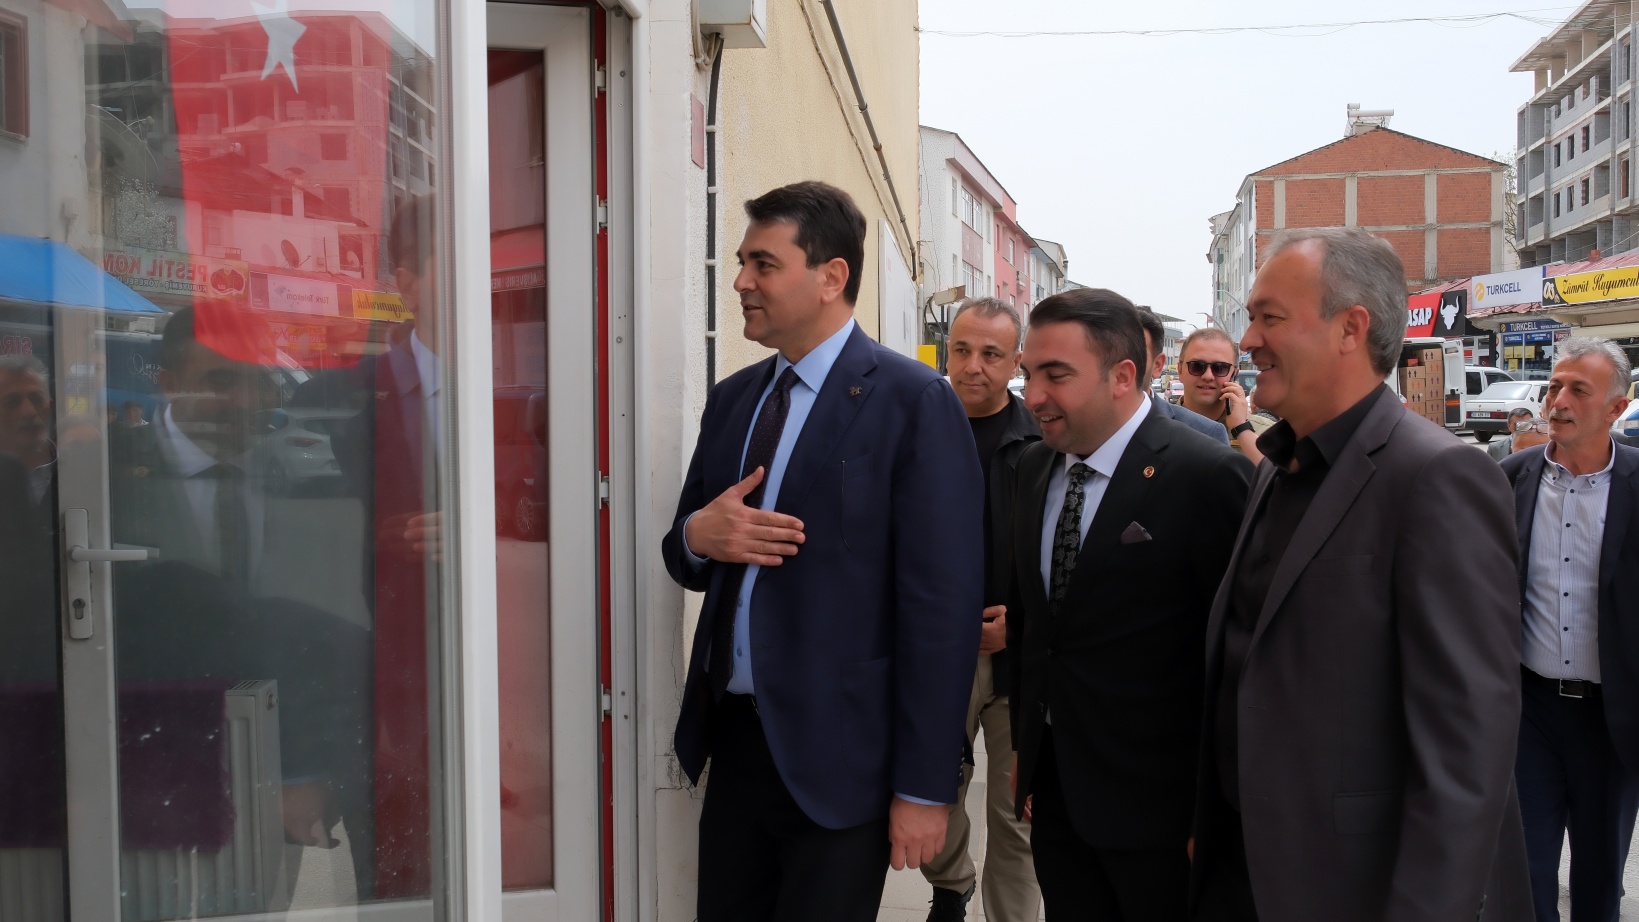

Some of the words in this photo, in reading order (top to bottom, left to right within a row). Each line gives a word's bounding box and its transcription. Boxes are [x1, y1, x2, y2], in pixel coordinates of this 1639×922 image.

[1486, 281, 1522, 297] TURKCELL
[1562, 279, 1589, 295] Zümrüt
[1407, 307, 1433, 327] ASAP
[1509, 321, 1538, 331] TURKCELL
